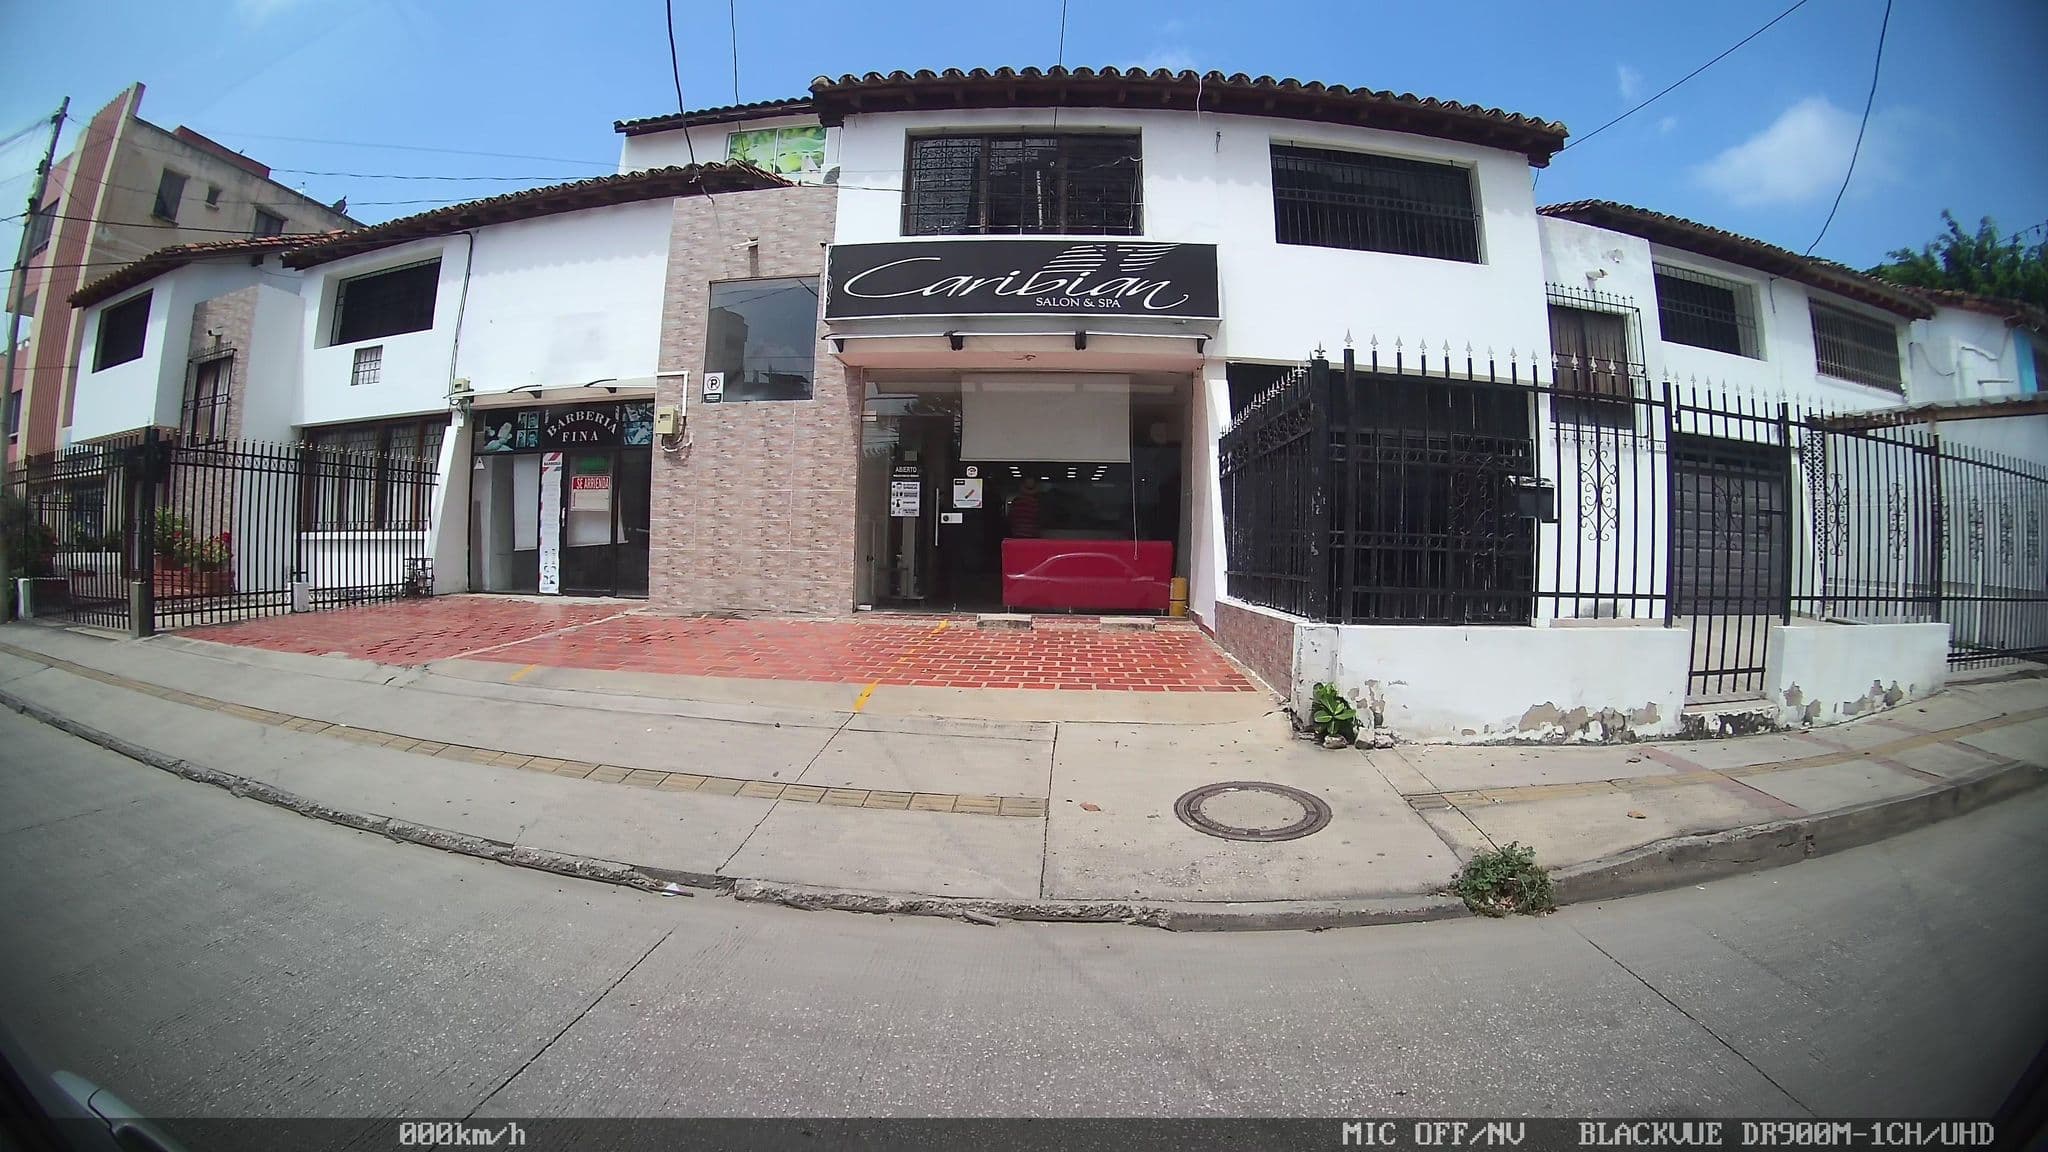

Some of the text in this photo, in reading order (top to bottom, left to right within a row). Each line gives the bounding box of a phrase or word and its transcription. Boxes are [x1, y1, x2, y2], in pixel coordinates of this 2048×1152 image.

[843, 256, 1189, 310] Caribian
[1035, 297, 1121, 308] SALON & SPA
[546, 410, 617, 437] BARBERIA
[562, 430, 598, 442] FINA
[576, 478, 609, 489] SE ARRIENDA
